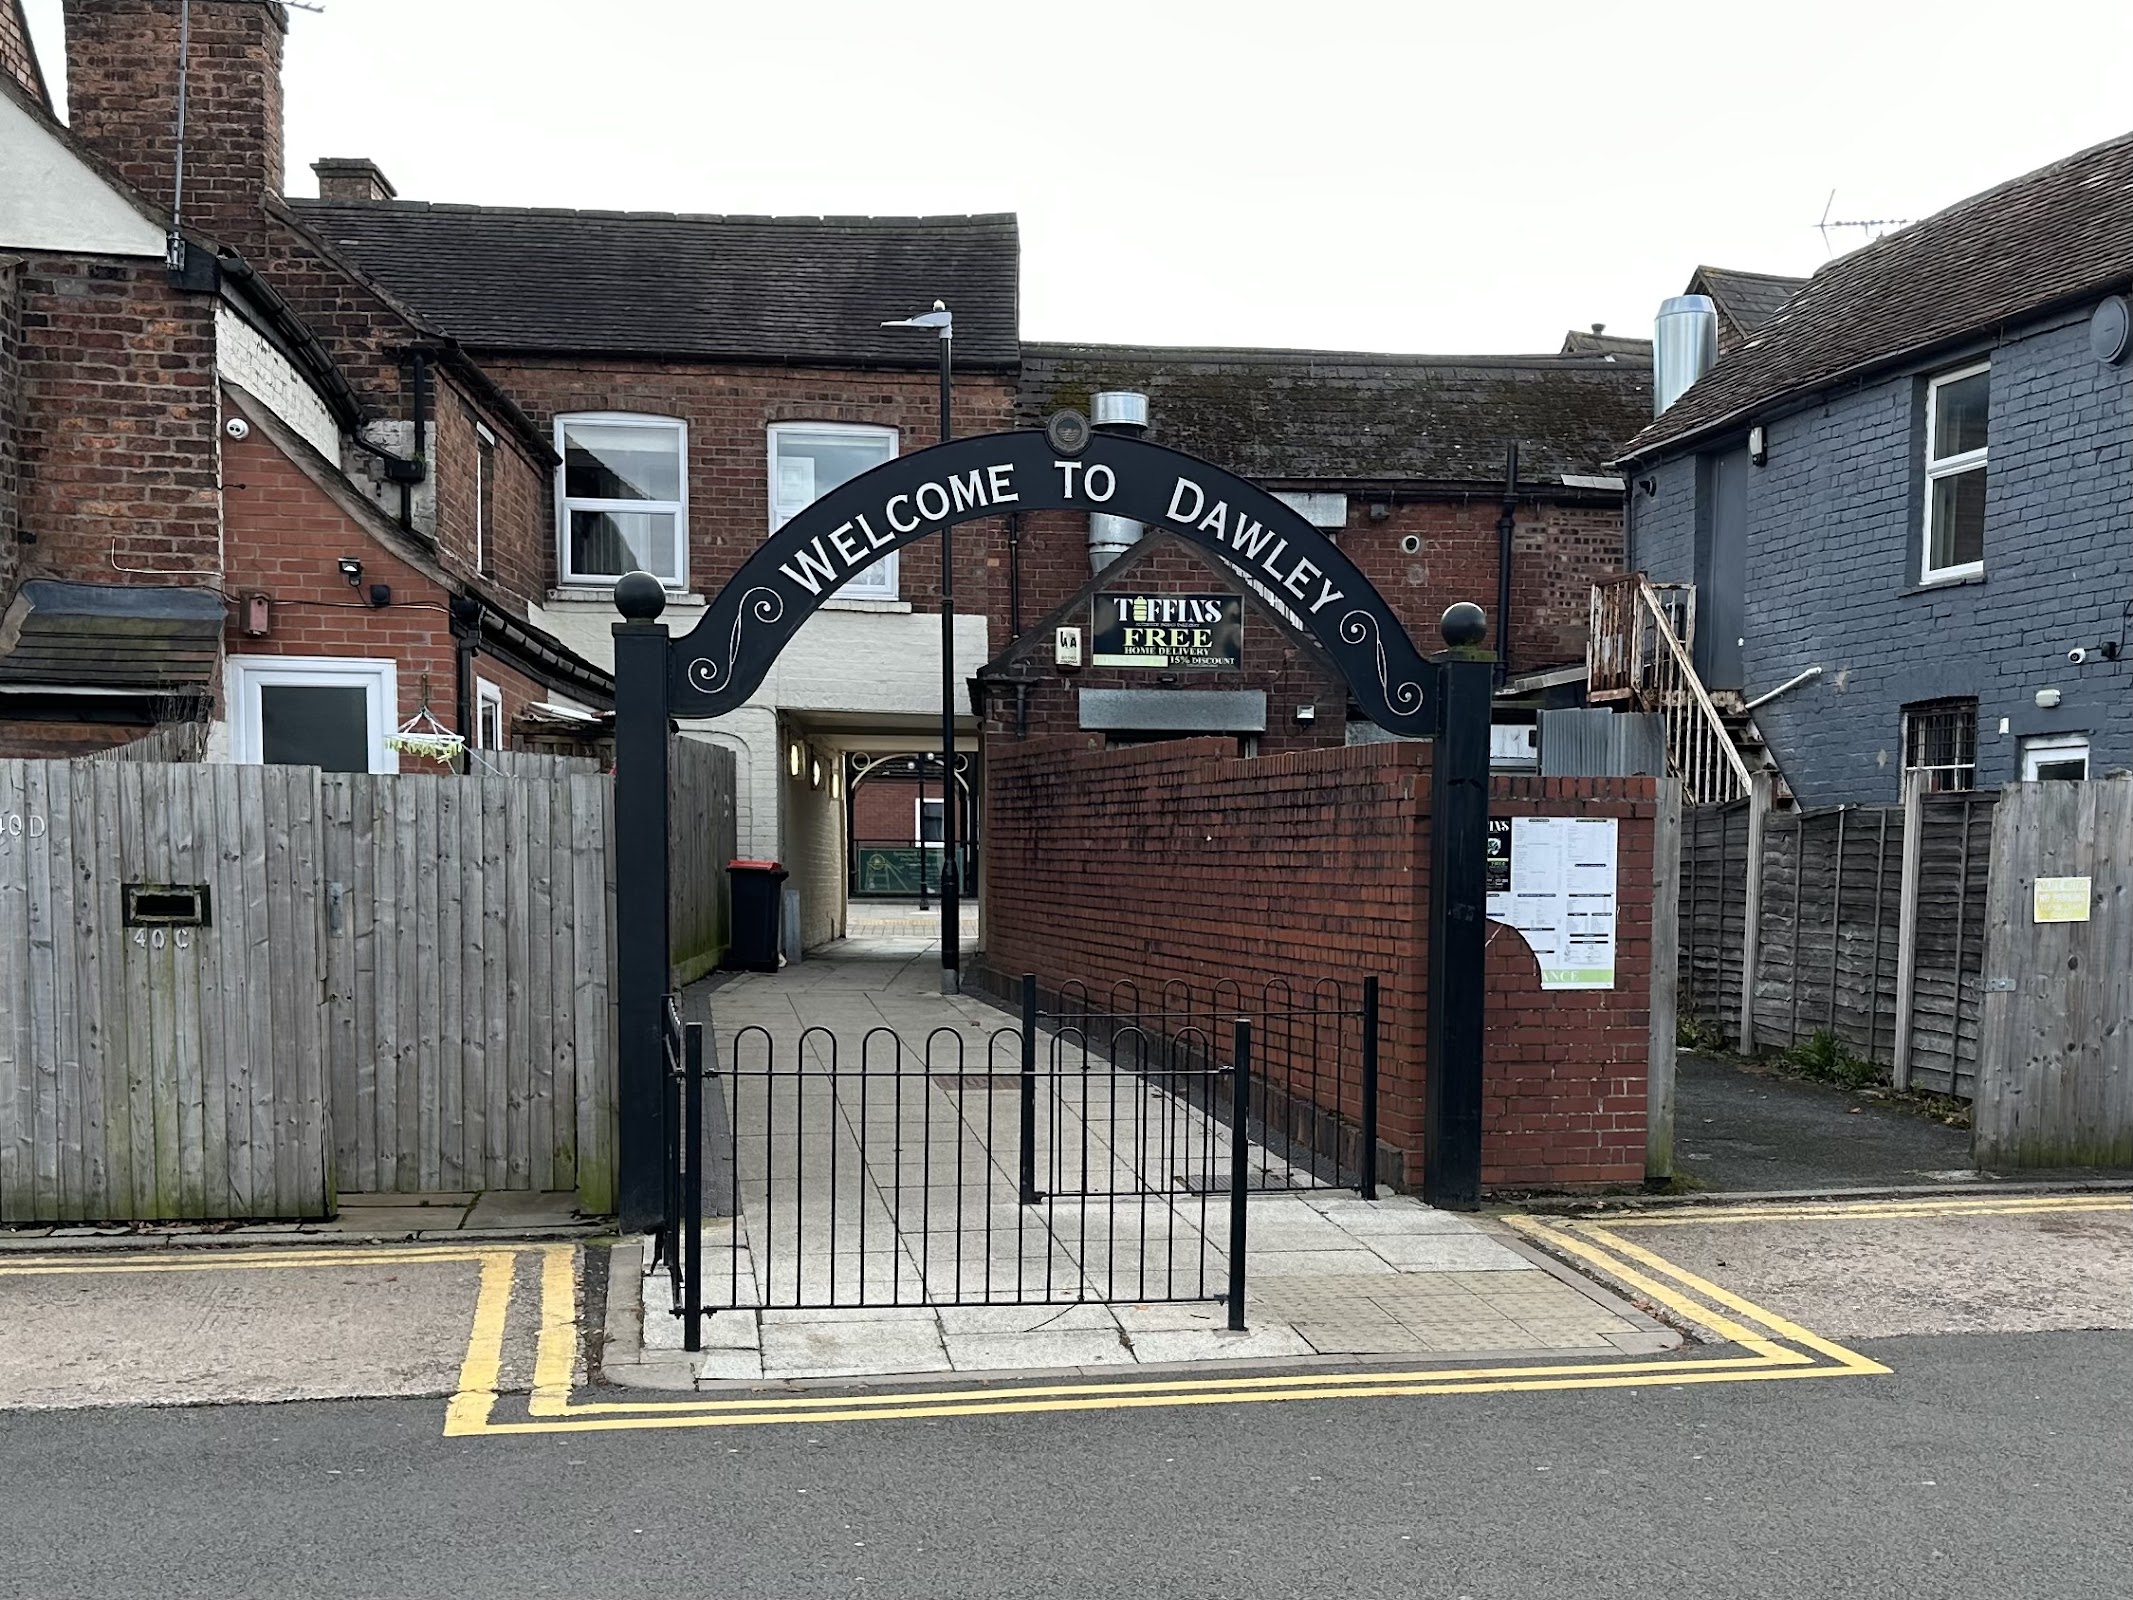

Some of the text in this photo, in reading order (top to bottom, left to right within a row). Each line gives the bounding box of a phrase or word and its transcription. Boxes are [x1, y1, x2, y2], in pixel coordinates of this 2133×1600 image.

[779, 460, 1344, 614] WELCOME TO DAWLEY
[1122, 627, 1213, 648] FREE
[1124, 647, 1209, 656] HOME DELIVERY
[1169, 656, 1191, 664] 15%
[1191, 657, 1235, 666] DISCOUNT
[1488, 820, 1510, 832] INS
